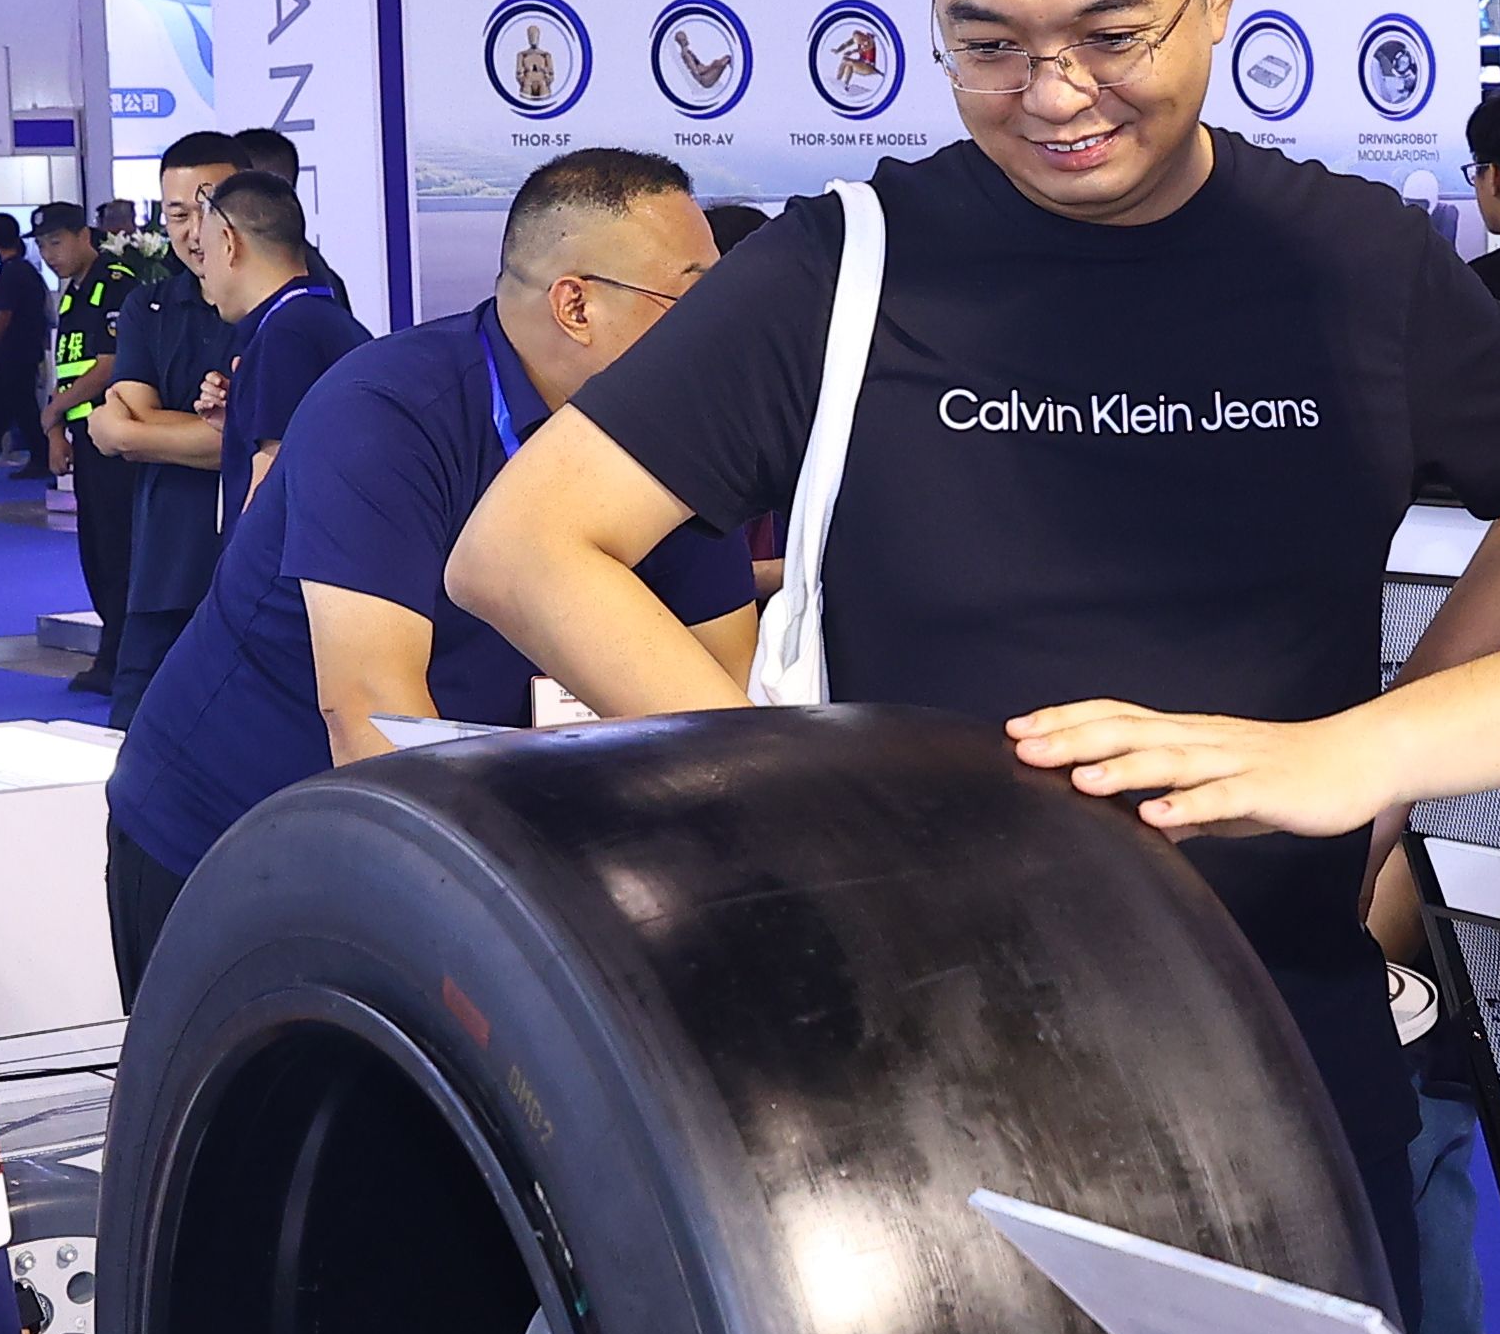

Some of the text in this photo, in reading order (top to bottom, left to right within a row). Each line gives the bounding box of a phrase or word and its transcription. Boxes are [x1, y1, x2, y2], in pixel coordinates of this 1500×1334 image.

[674, 132, 734, 146] THOR-AV
[859, 133, 874, 146] FE
[876, 133, 927, 146] MODELS
[1358, 133, 1438, 145] DRIVINGROBOT
[937, 387, 1320, 435] Calvin Klein Jeans
